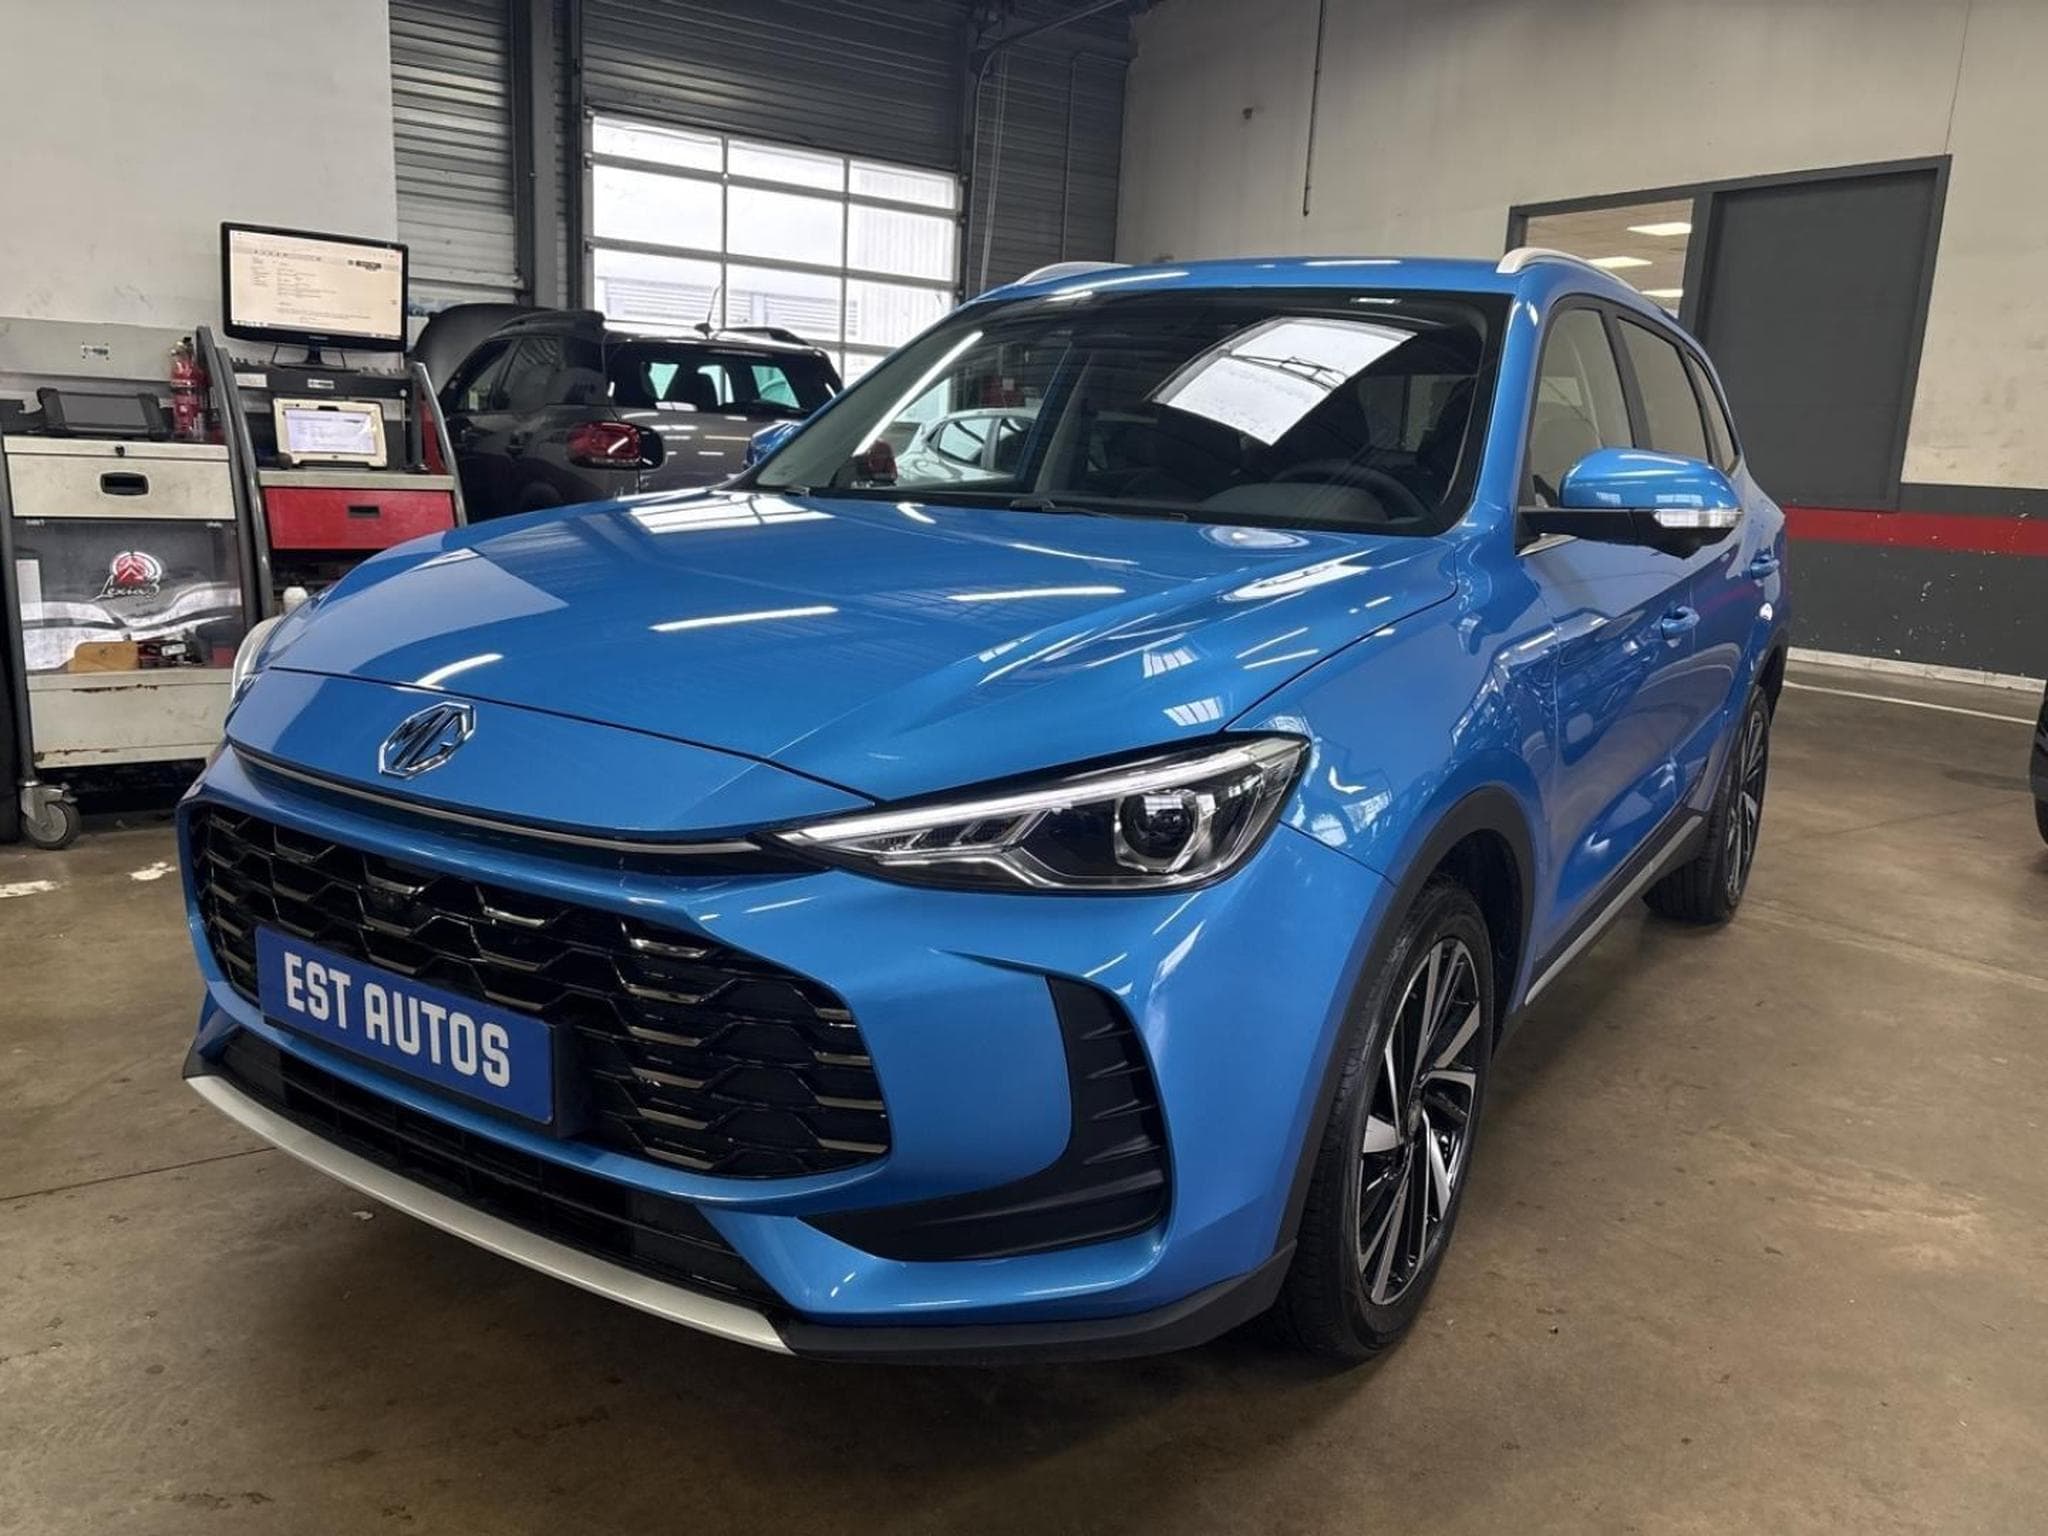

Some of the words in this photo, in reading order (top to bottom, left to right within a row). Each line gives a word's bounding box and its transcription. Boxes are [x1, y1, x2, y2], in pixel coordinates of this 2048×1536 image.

[380, 702, 475, 778] MG
[284, 951, 350, 1029] EST
[364, 982, 510, 1088] AUTOS
